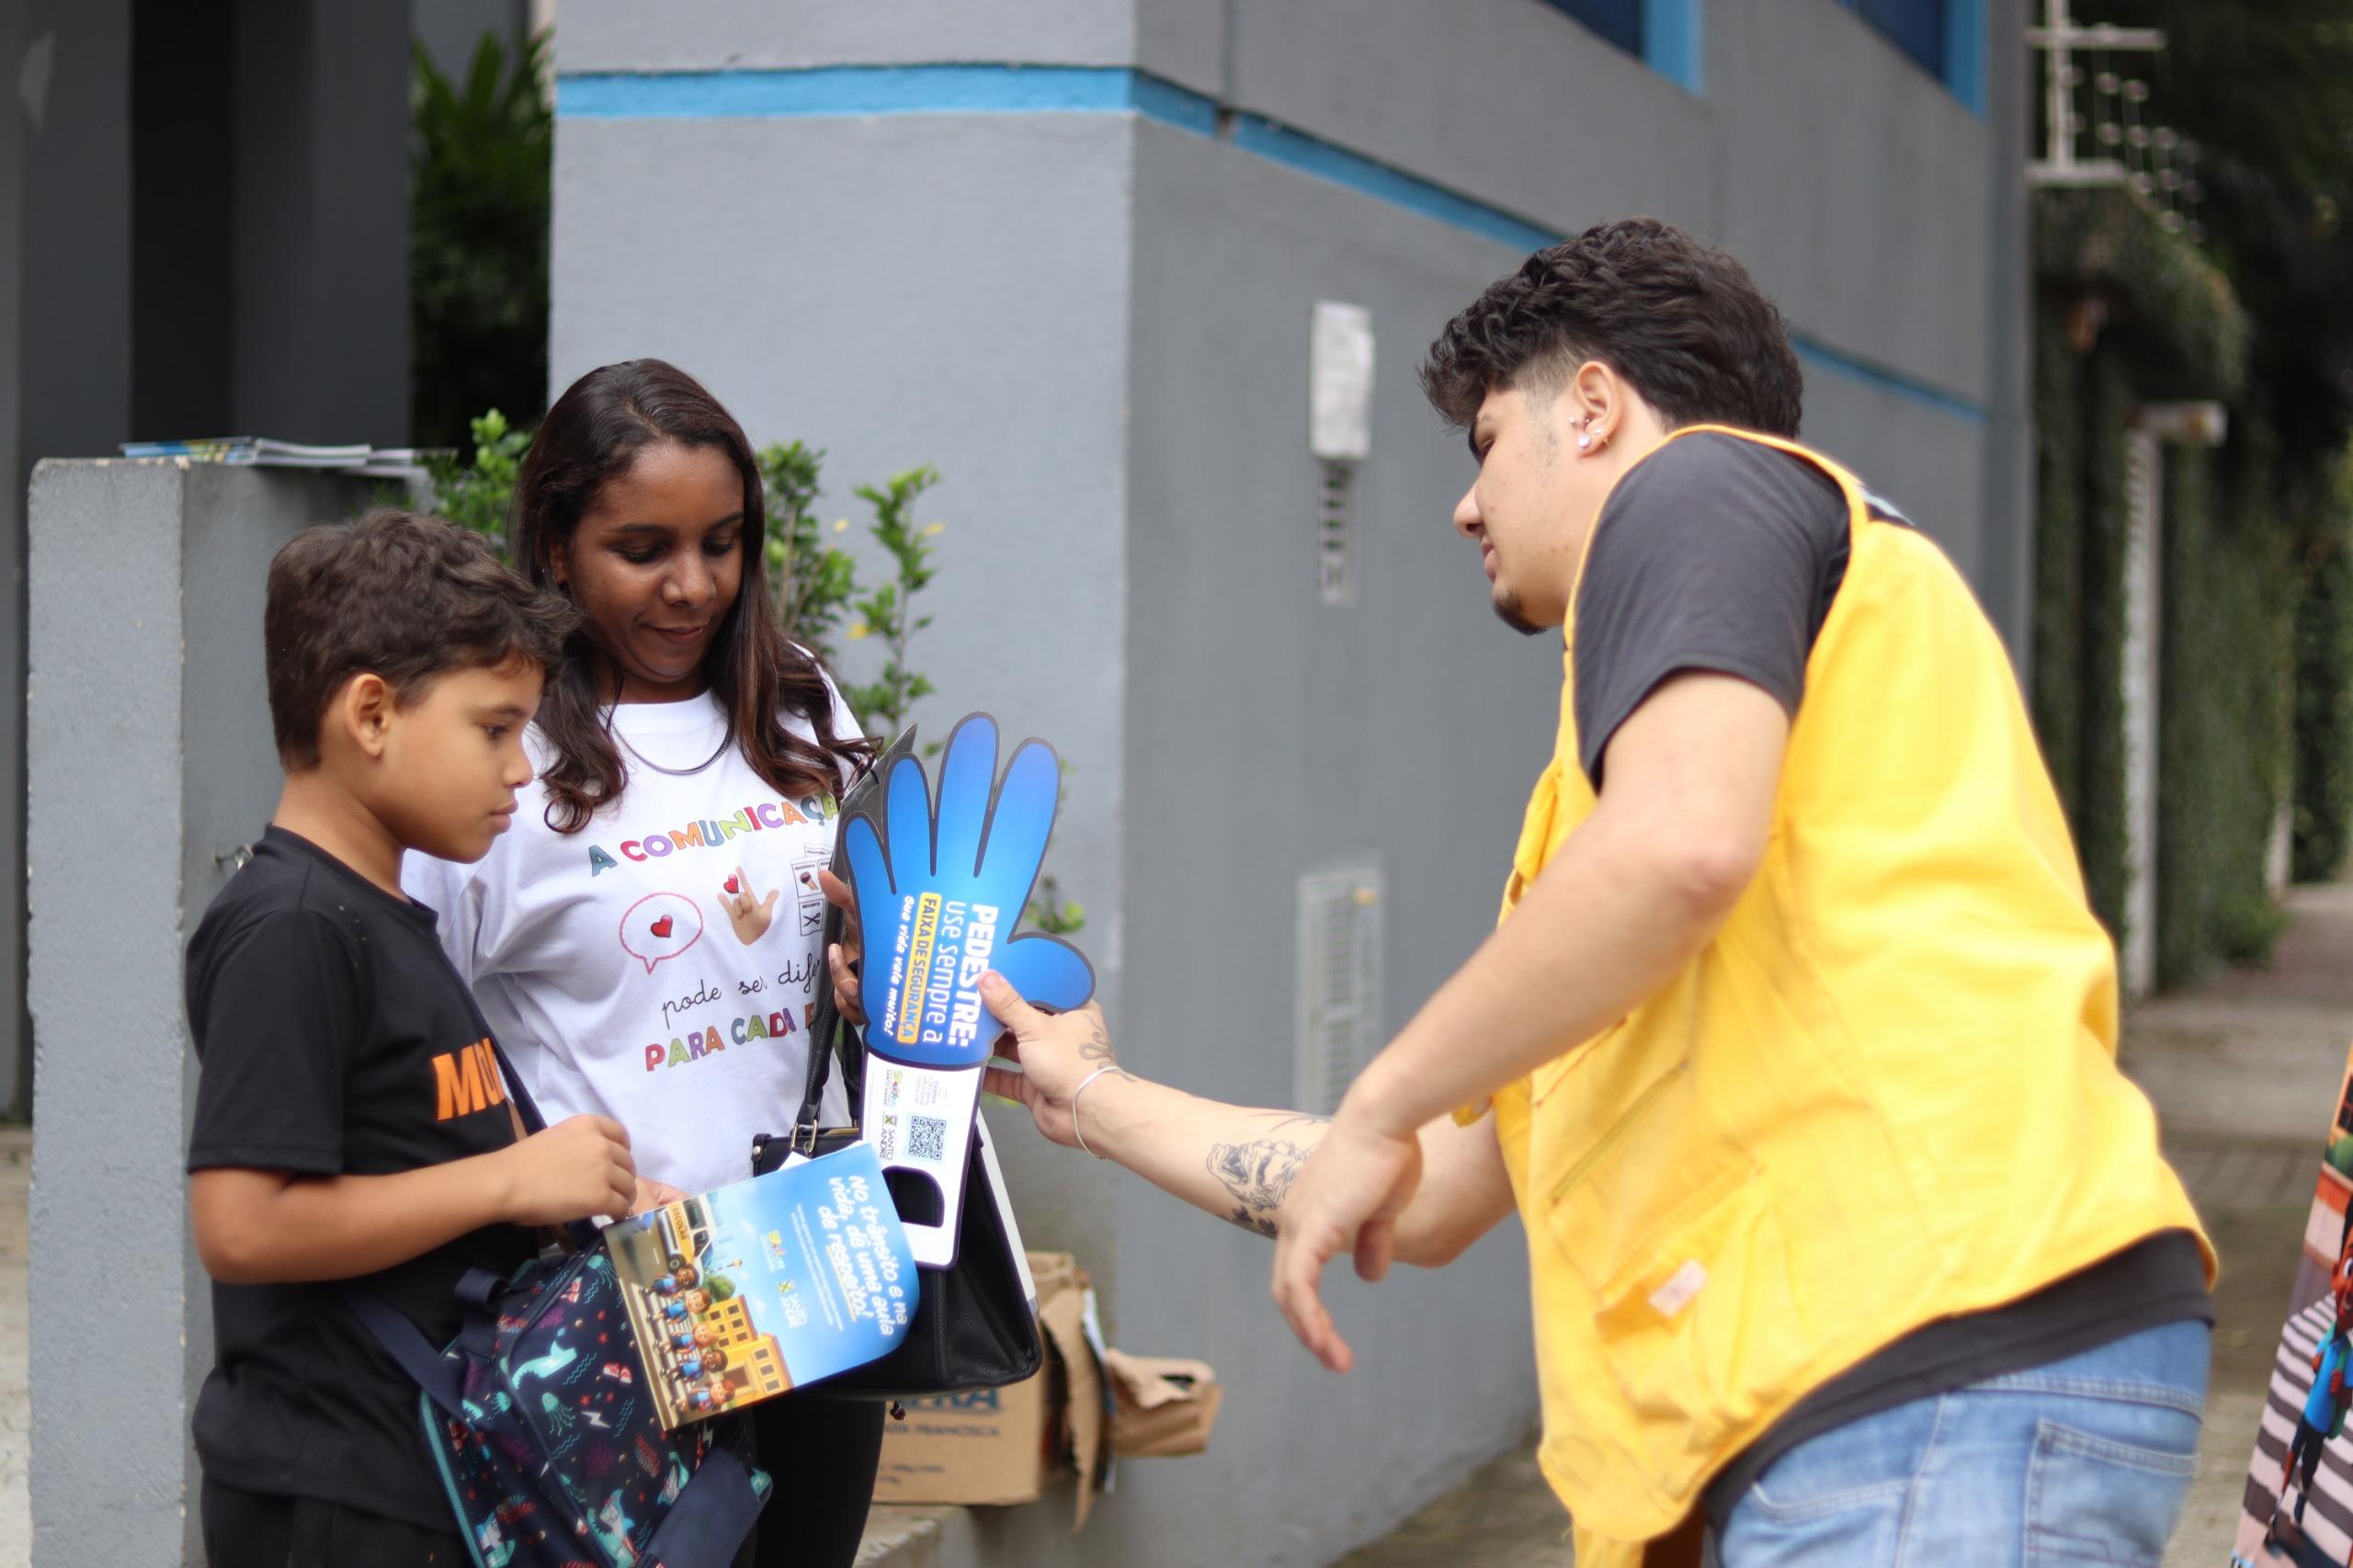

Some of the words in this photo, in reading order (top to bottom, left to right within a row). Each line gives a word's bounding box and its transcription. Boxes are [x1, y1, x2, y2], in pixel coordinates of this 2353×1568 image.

[588, 844, 618, 877] A
[918, 898, 937, 937] FAIXA
[941, 901, 965, 938] use
[896, 925, 909, 953] vida
[915, 939, 931, 957] DE
[891, 957, 903, 984] vale
[926, 943, 959, 1025] sempre
[949, 904, 998, 1045] PEDESTRE:
[662, 979, 722, 1029] pode
[883, 988, 897, 1036] muito!
[900, 959, 926, 1037] SEGURANÇA
[646, 1025, 725, 1072] PARA
[923, 1030, 943, 1042] a
[883, 1129, 894, 1160] SANTO
[829, 1177, 854, 1220] vida,
[850, 1176, 870, 1200] No
[672, 1207, 688, 1240] ESCOLAR
[818, 1206, 838, 1229] de
[845, 1227, 869, 1247] dê
[860, 1206, 898, 1280] trânsito
[826, 1234, 873, 1317] respeito!
[856, 1252, 881, 1292] uma
[888, 1287, 904, 1298] e
[872, 1297, 894, 1335] aula
[894, 1301, 908, 1324] na
